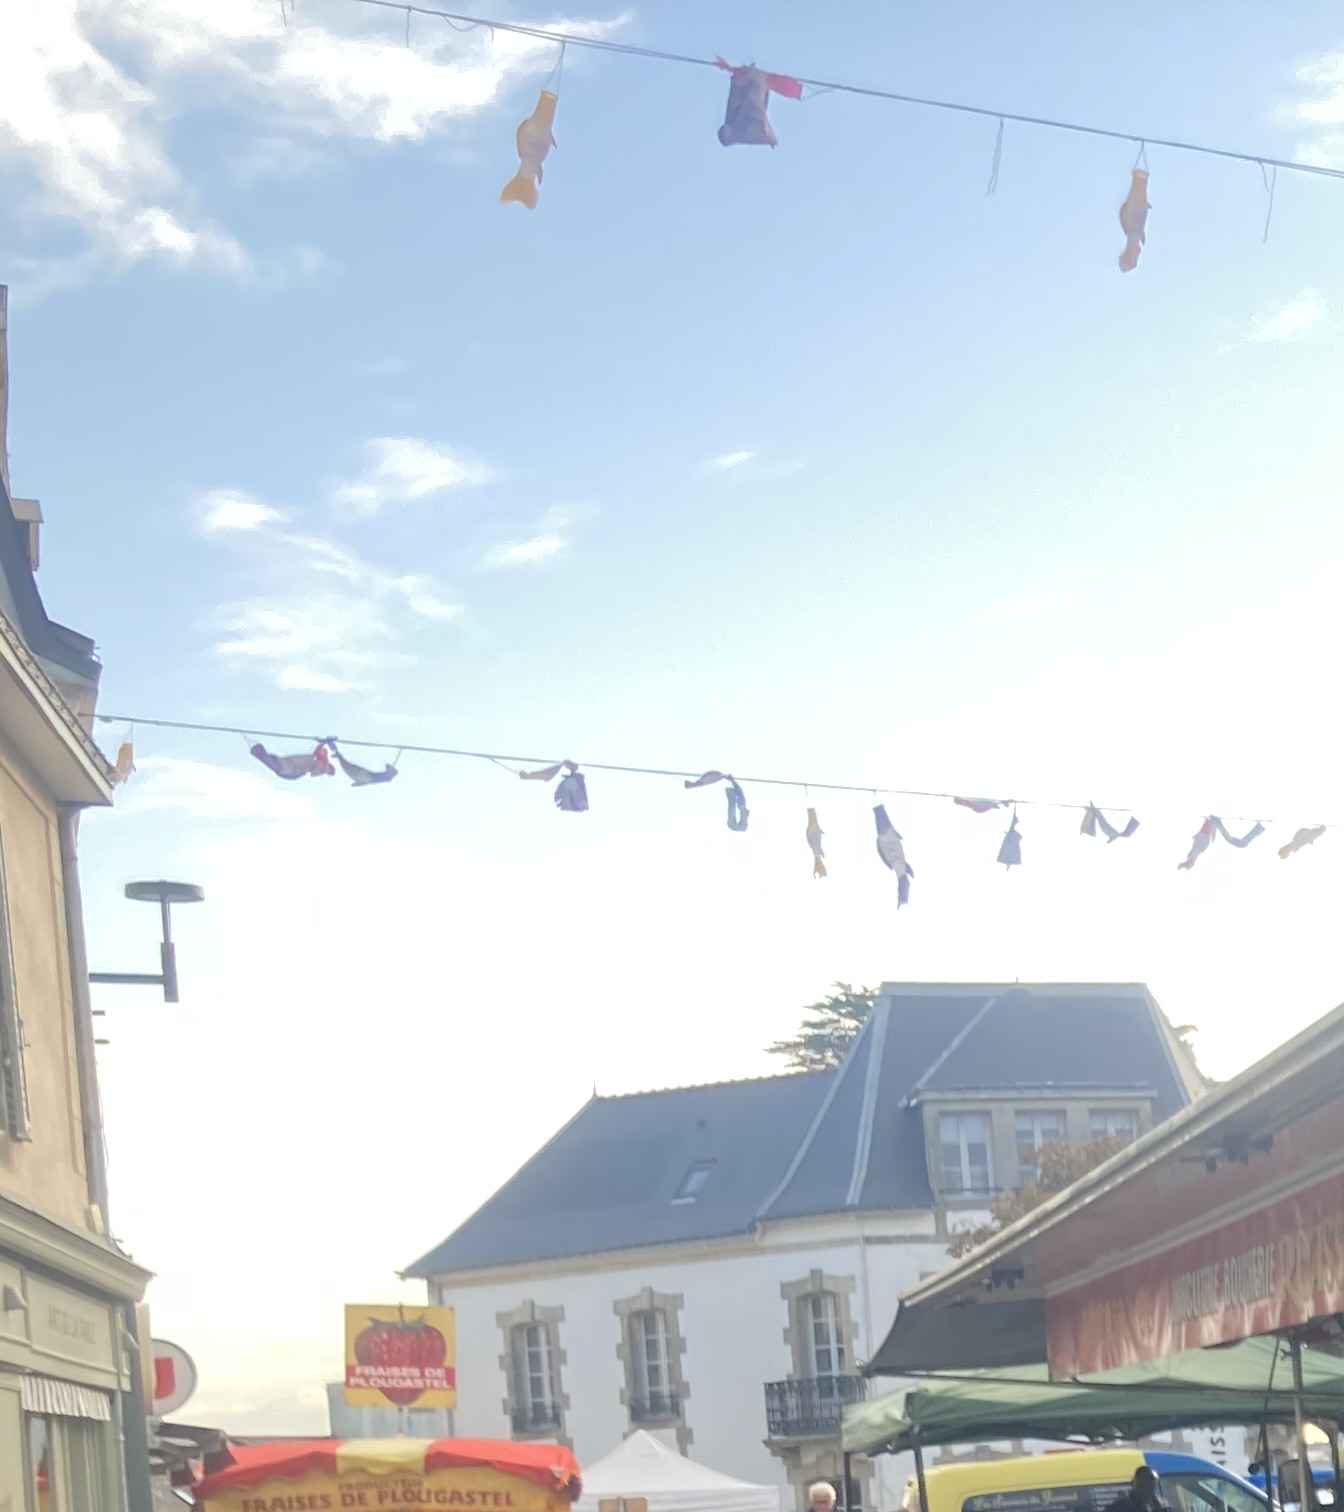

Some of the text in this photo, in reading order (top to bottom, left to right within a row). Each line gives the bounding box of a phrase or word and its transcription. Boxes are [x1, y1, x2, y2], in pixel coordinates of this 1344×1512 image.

[355, 1366, 446, 1378] FRAISES DE
[349, 1376, 449, 1389] PLOUGASTEL
[341, 1491, 368, 1507] DE
[378, 1488, 515, 1507] PLOUGASTEL
